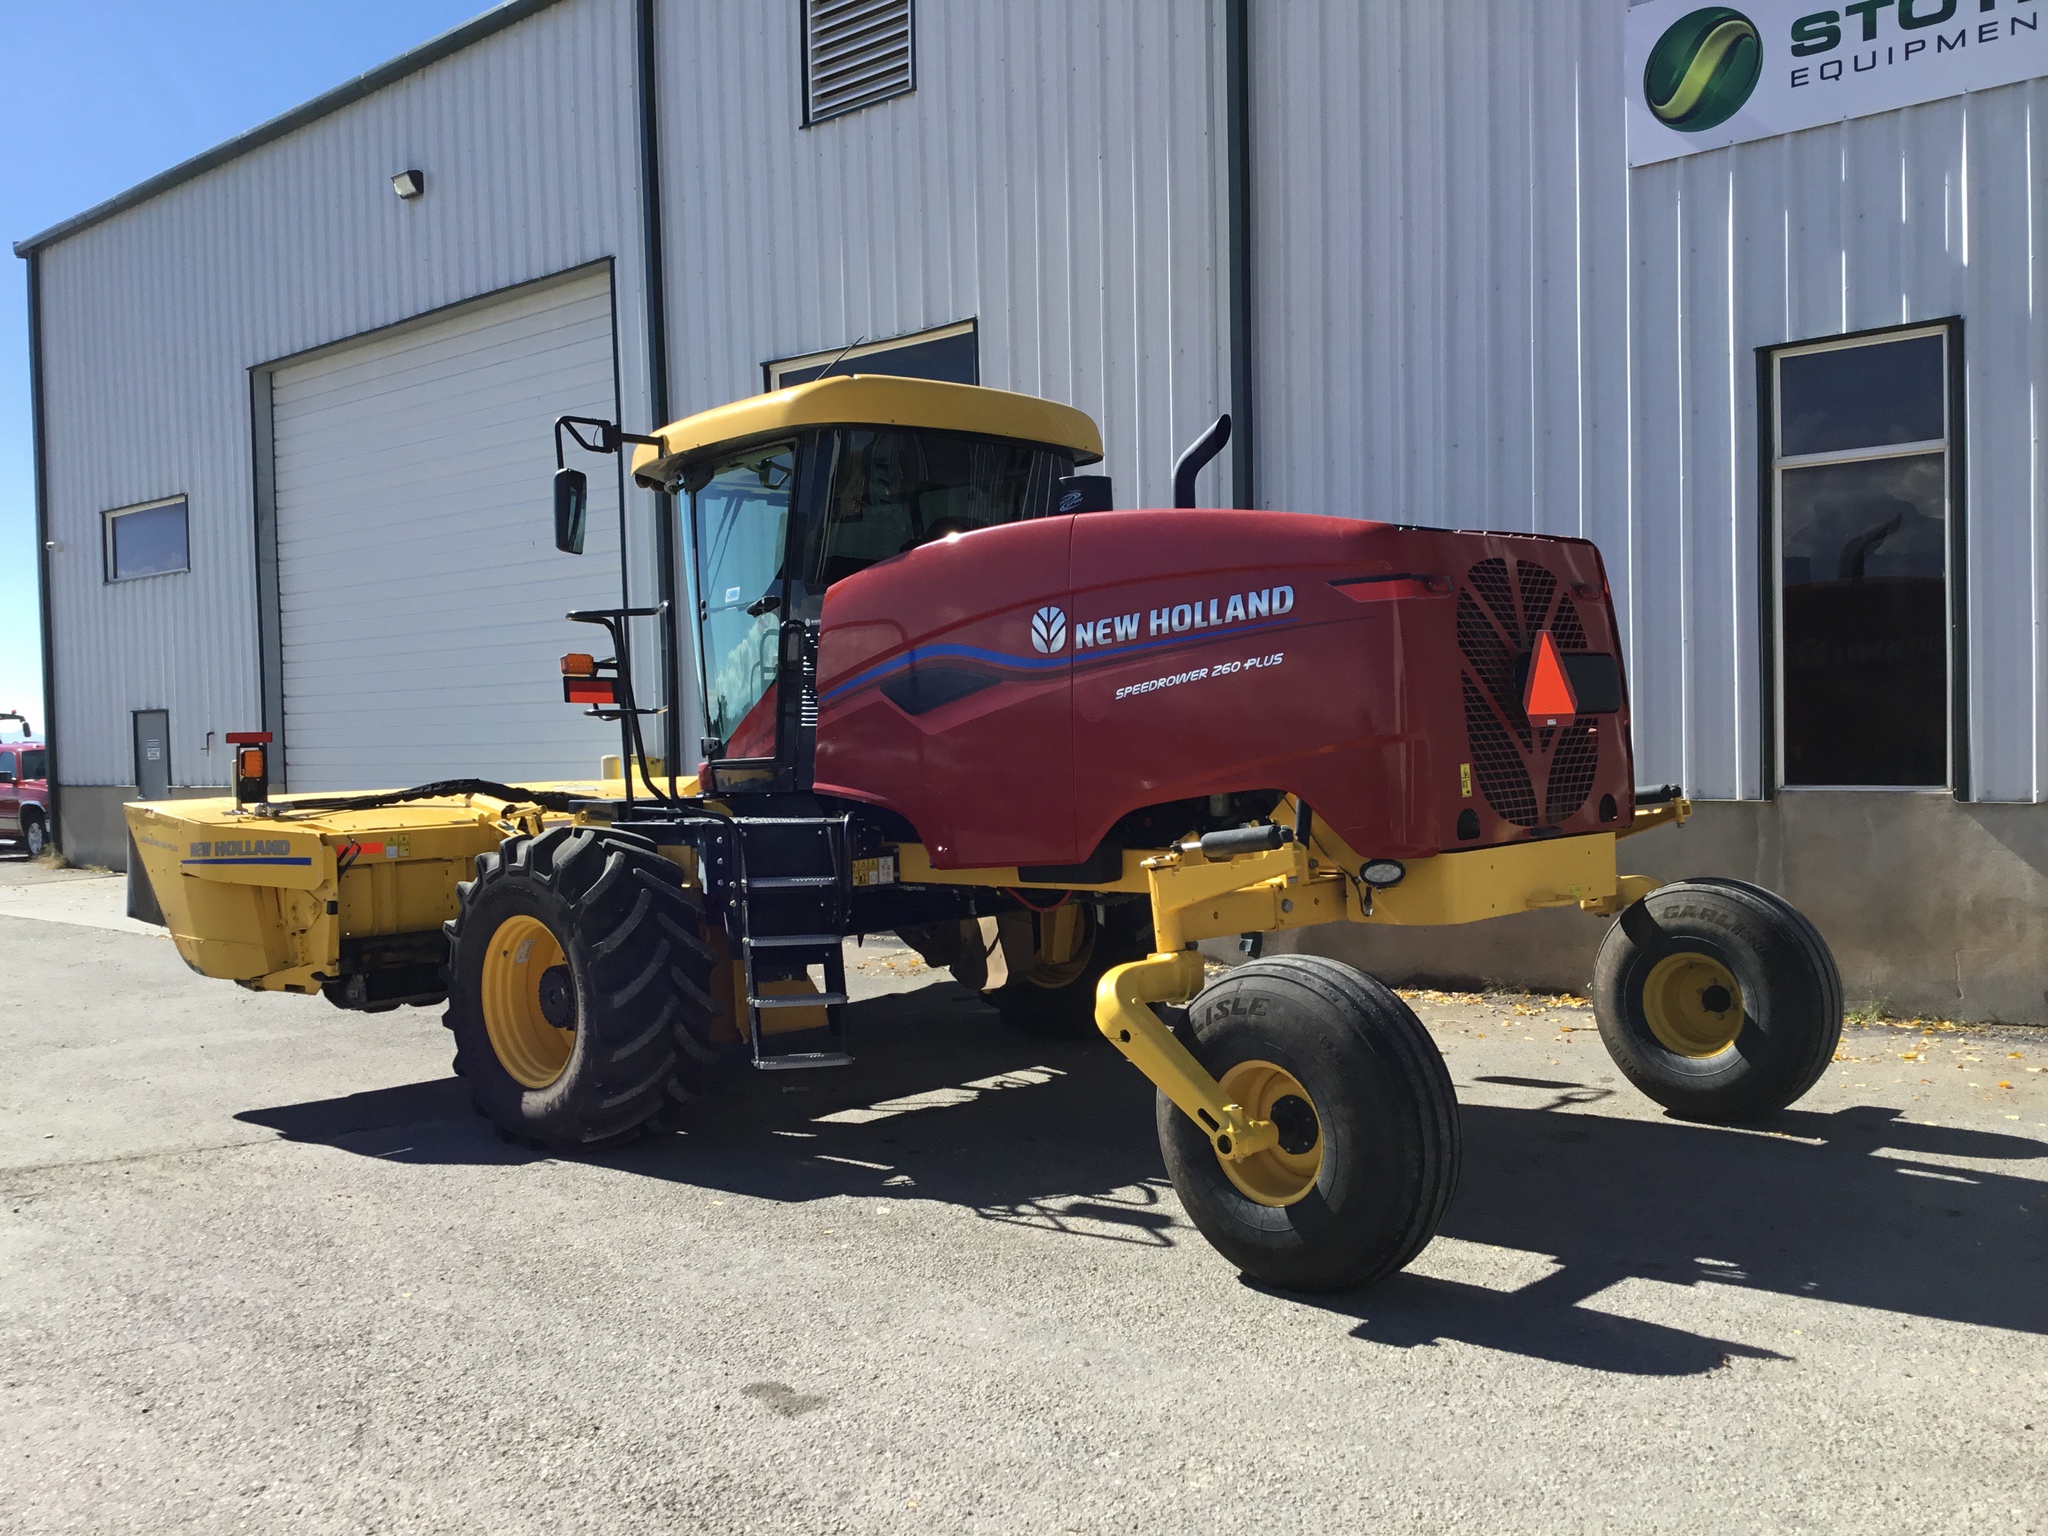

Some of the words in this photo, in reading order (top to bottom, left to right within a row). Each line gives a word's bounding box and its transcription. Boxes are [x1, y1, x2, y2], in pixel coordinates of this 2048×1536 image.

[1075, 612, 1140, 649] NEW
[1150, 585, 1294, 636] HOLLAND
[1115, 668, 1208, 700] SPEEDROWER
[1211, 661, 1241, 677] 260
[190, 841, 211, 857] NEW
[214, 839, 290, 857] HOLLAND
